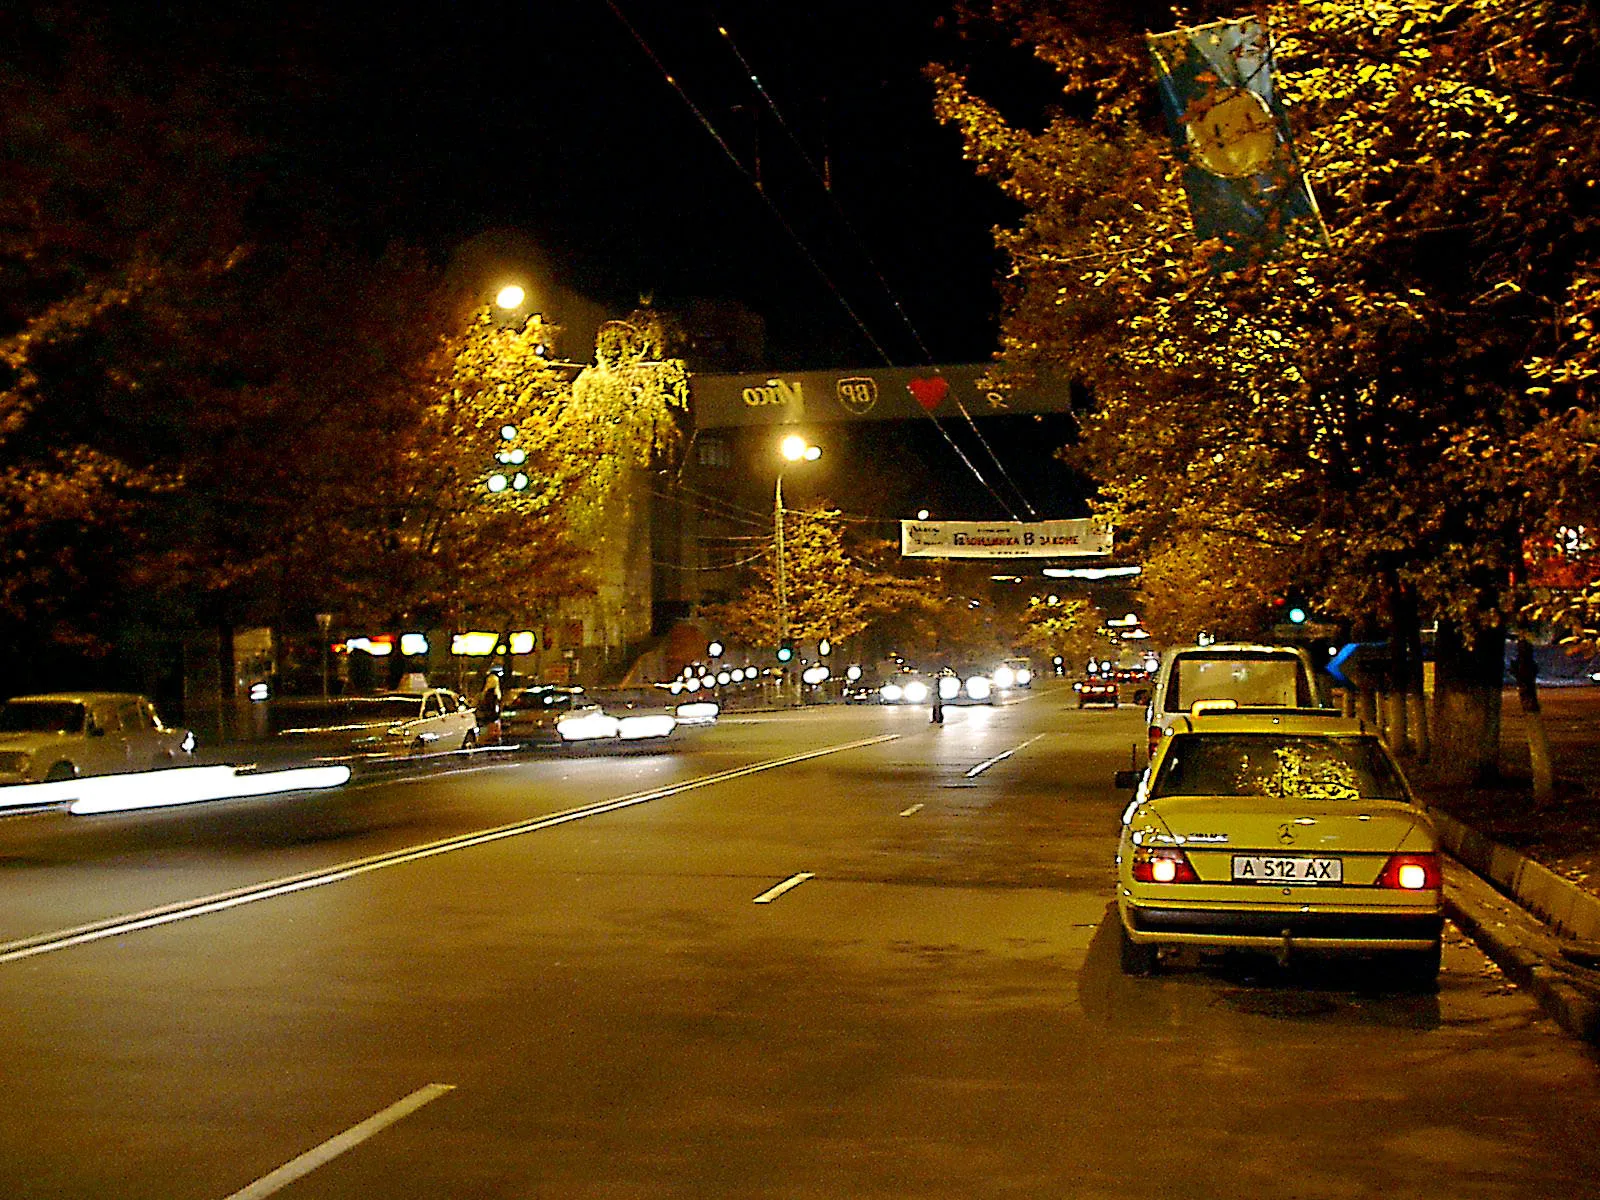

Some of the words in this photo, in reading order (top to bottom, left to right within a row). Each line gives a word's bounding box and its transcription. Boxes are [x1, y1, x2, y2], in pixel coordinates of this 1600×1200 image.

[1243, 859, 1254, 876] A
[1264, 860, 1296, 877] 512
[1305, 861, 1331, 879] AX
